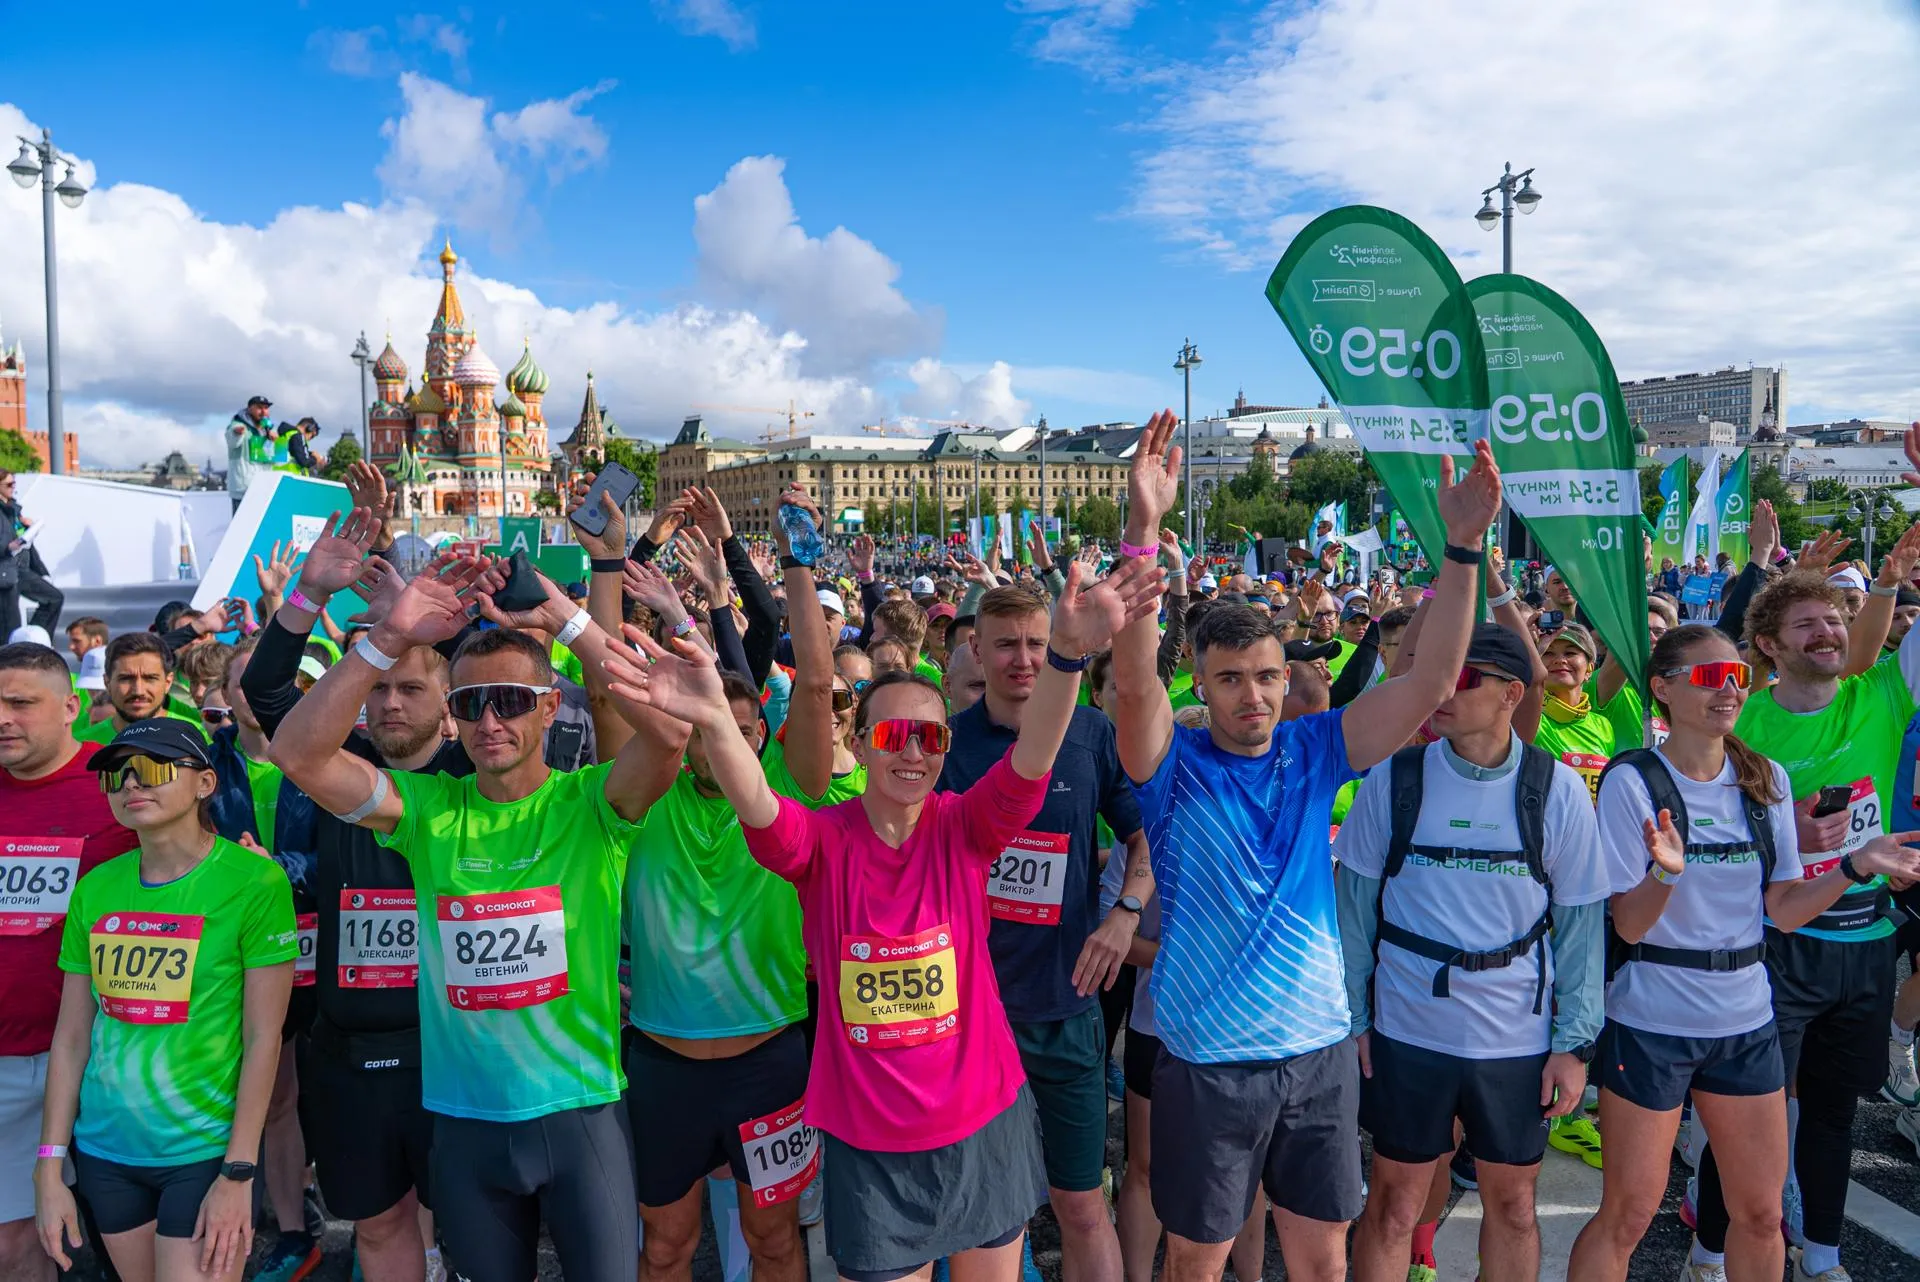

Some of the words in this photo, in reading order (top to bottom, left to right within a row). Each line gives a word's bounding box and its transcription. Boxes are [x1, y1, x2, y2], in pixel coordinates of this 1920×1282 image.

[999, 884, 1035, 895] ВИКТОР
[346, 919, 419, 948] 1168
[455, 924, 547, 964] 8224
[95, 944, 188, 980] 11073
[358, 950, 415, 959] АЛЕКСАНДР
[475, 962, 529, 977] ЕВГЕНИЙ
[109, 979, 157, 991] КРИСТИНА
[856, 964, 944, 1004] 8558
[871, 1001, 935, 1016] ЕКАТЕРИНА
